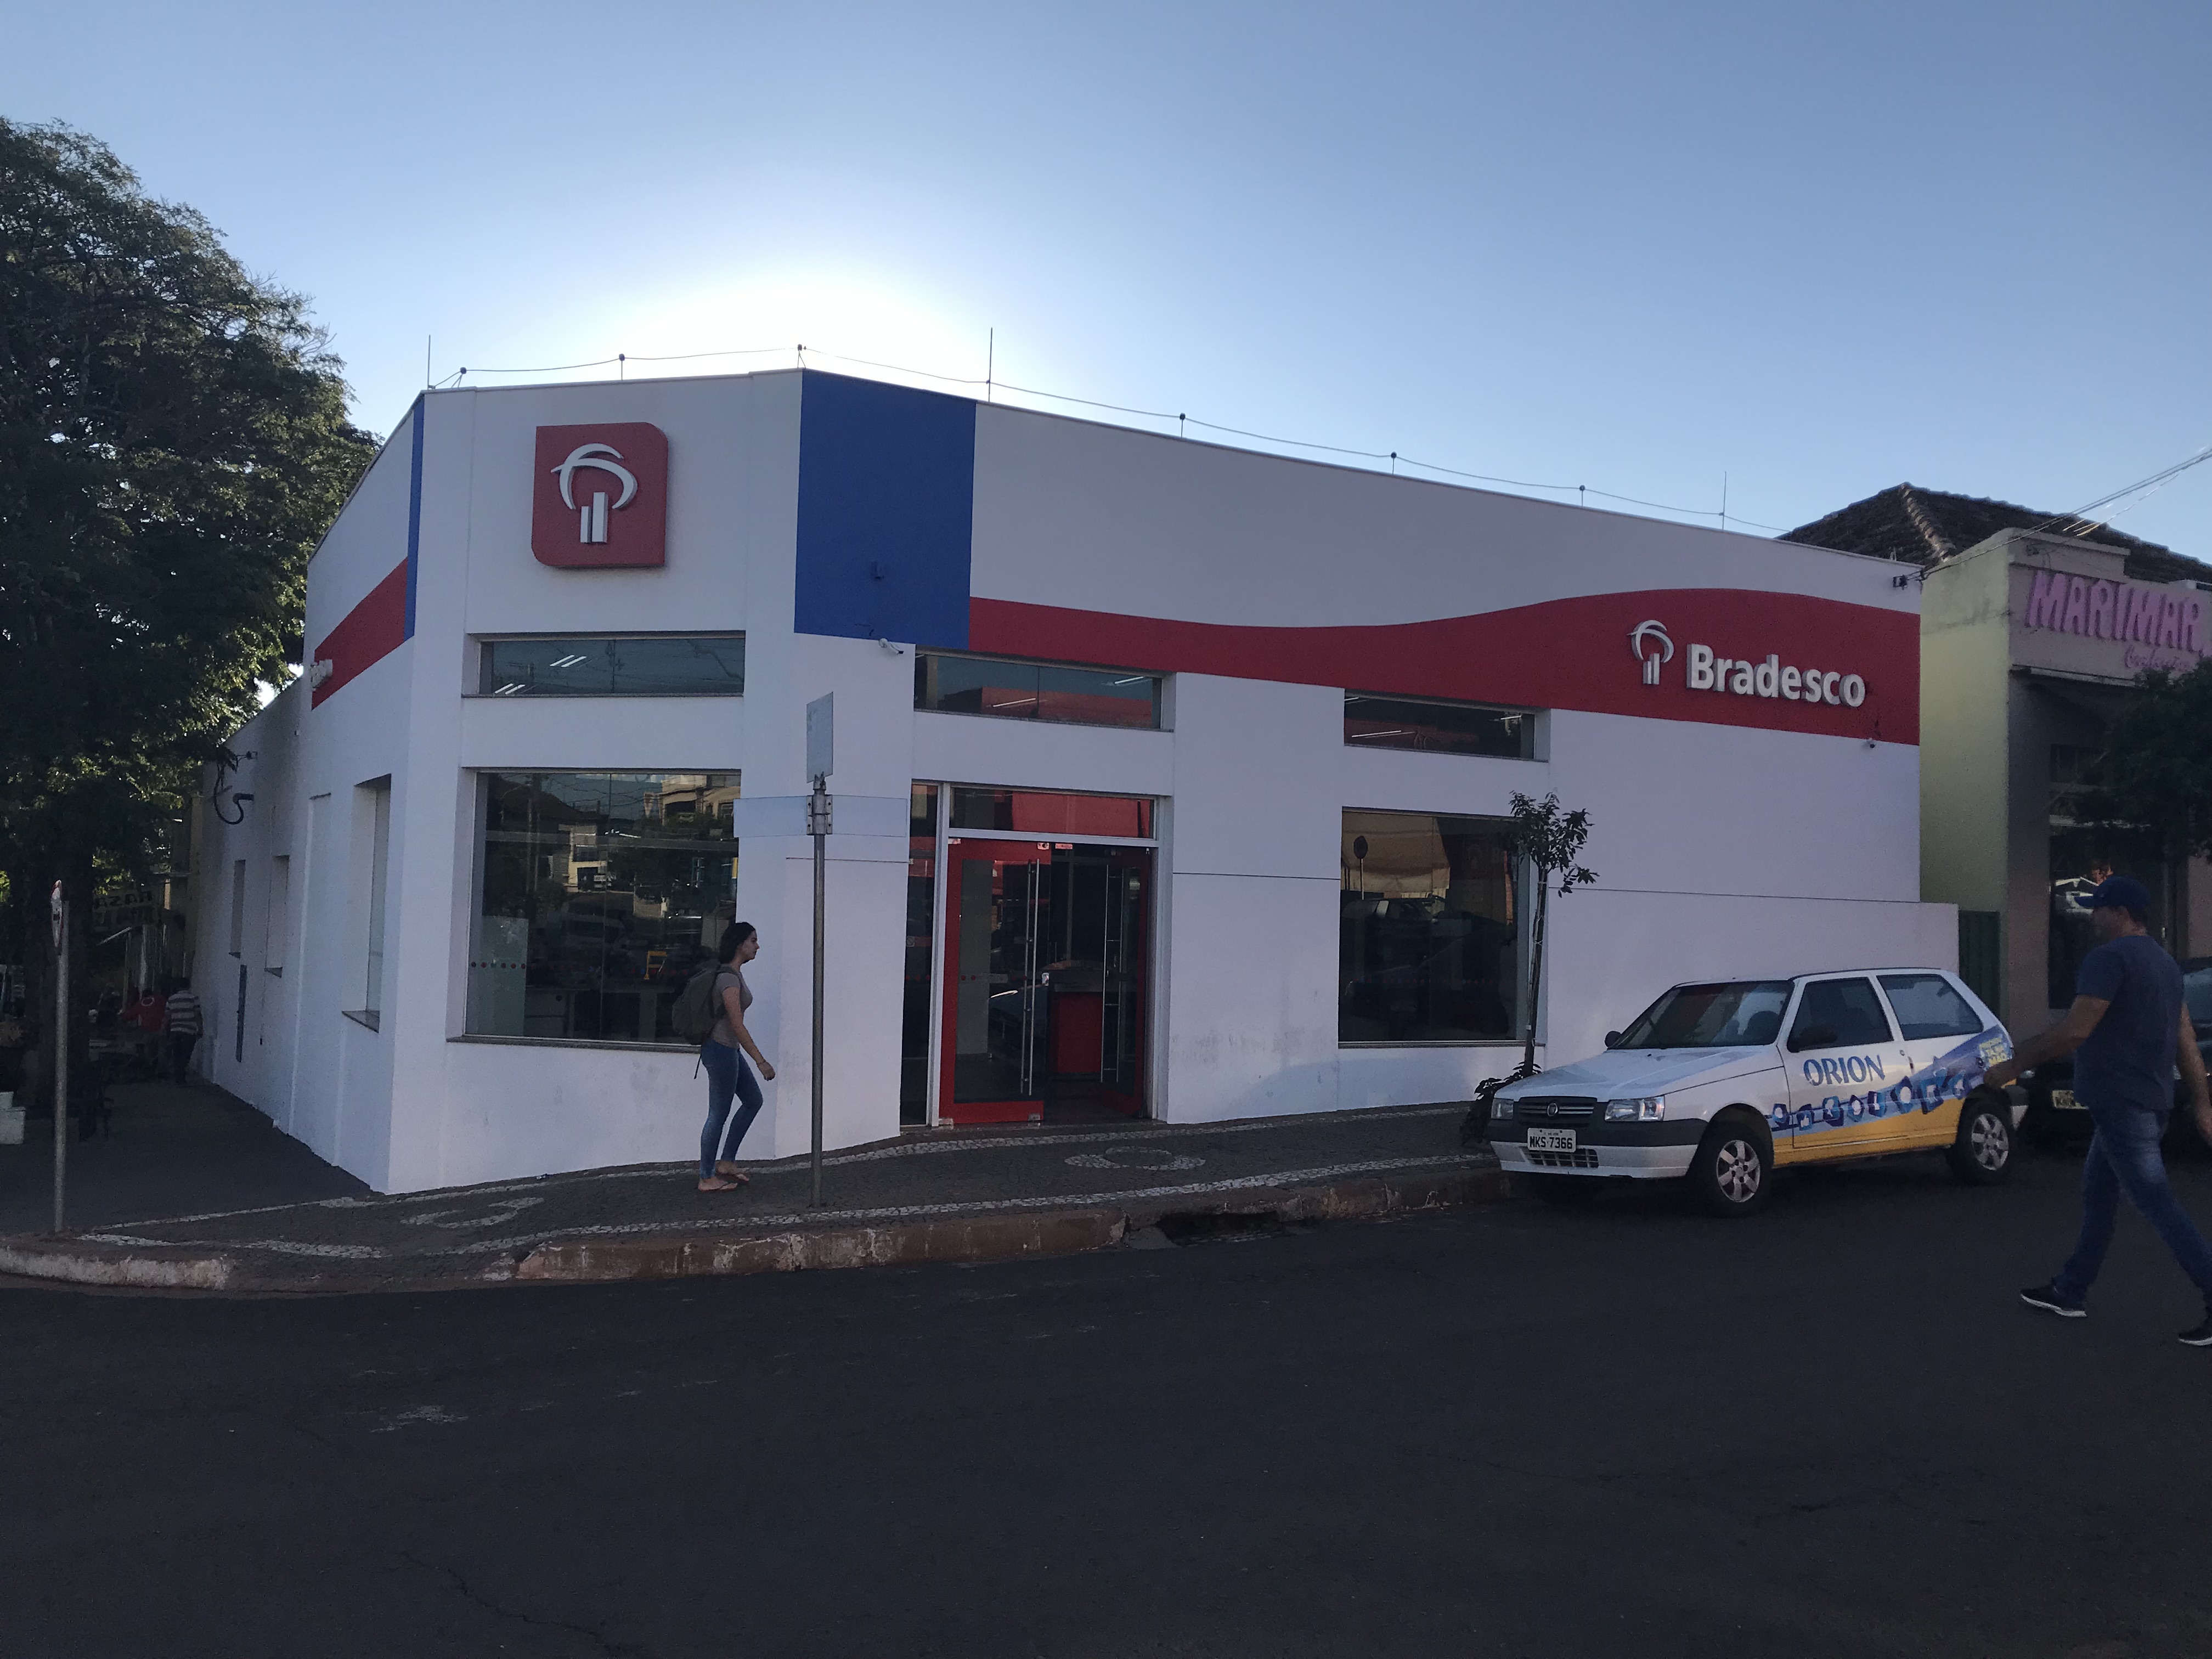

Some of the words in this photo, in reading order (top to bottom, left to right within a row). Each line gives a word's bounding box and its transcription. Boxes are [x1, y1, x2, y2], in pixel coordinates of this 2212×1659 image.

[2025, 569, 2205, 653] MARIMAR
[1686, 644, 1865, 707] Bradesco
[1803, 1054, 1886, 1086] ORION
